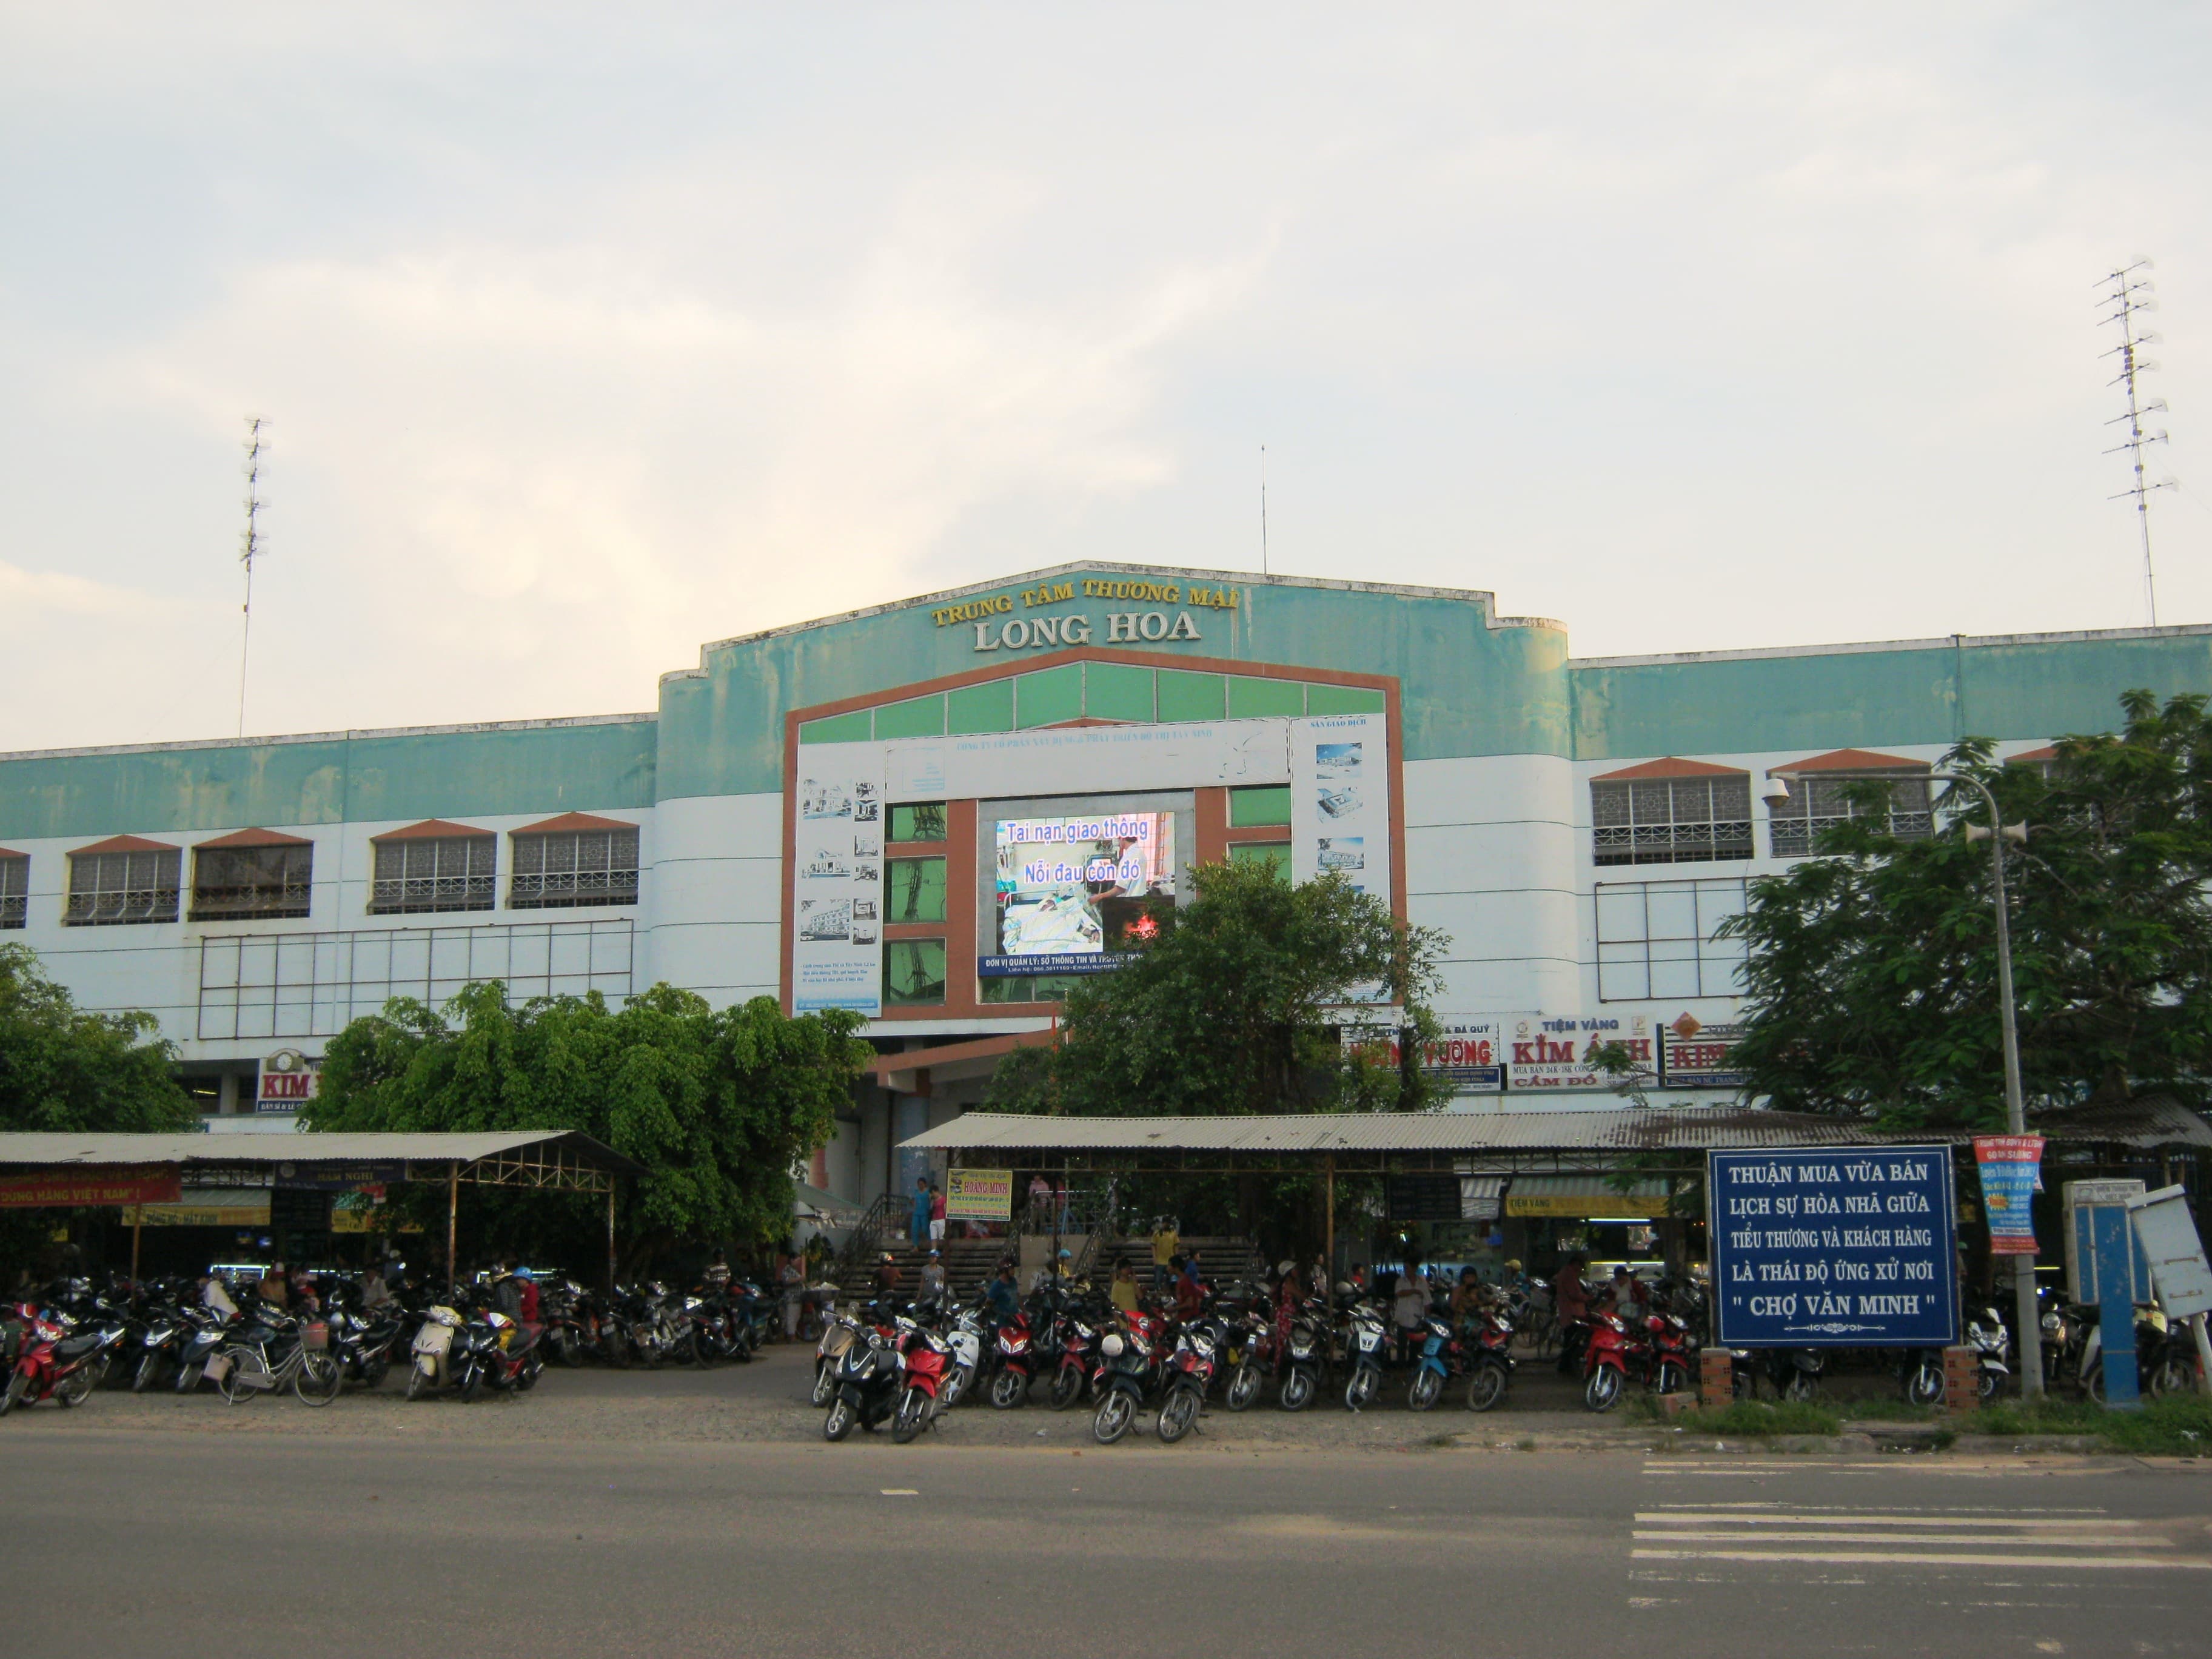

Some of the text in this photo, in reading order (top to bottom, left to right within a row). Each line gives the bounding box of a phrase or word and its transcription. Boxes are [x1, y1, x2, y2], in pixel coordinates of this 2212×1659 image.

[932, 579, 1239, 627] TRUNG TÂM THƯƠNG MẠI
[974, 611, 1201, 652] LONG HOA
[1007, 818, 1148, 845] Tai nạn giao thông
[1025, 859, 1139, 883] Nỗi đau còn đó
[986, 959, 1000, 967] ĐƠN
[1001, 959, 1008, 968] VỊ
[1009, 956, 1028, 966] QUẢN
[1029, 956, 1039, 965] LÝ:
[1041, 955, 1050, 965] SỞ
[1051, 954, 1074, 965] THÔNG
[1089, 954, 1097, 963] VÀ
[1543, 1017, 1619, 1033] TIỆM VÀNG
[1512, 1033, 1652, 1064] KIM ÁH
[1672, 1043, 1726, 1068] KIM
[1530, 1065, 1544, 1074] BÁN
[1567, 1073, 1598, 1085] ĐỒ
[262, 1074, 310, 1098] KIM
[1729, 1159, 1928, 1187] THUẬN MUA VỪA BÁN
[37, 1188, 69, 1201] HÀNG
[73, 1186, 99, 1204] VIỆT
[965, 1179, 1008, 1194] HOÀNG MINH
[1730, 1190, 1930, 1219] LỊCH SỰ HÒA NHÃ GIỮA
[1731, 1221, 1932, 1248] TIỂU THƯƠNG VÀ KHÁCH HÀNG
[1732, 1256, 1934, 1285] LÀ THÁI ĐỘ ỨNG XỬ NƠI
[1750, 1293, 1797, 1320] CHỢ
[1805, 1290, 1851, 1315] VĂN
[1858, 1295, 1920, 1315] MINH
